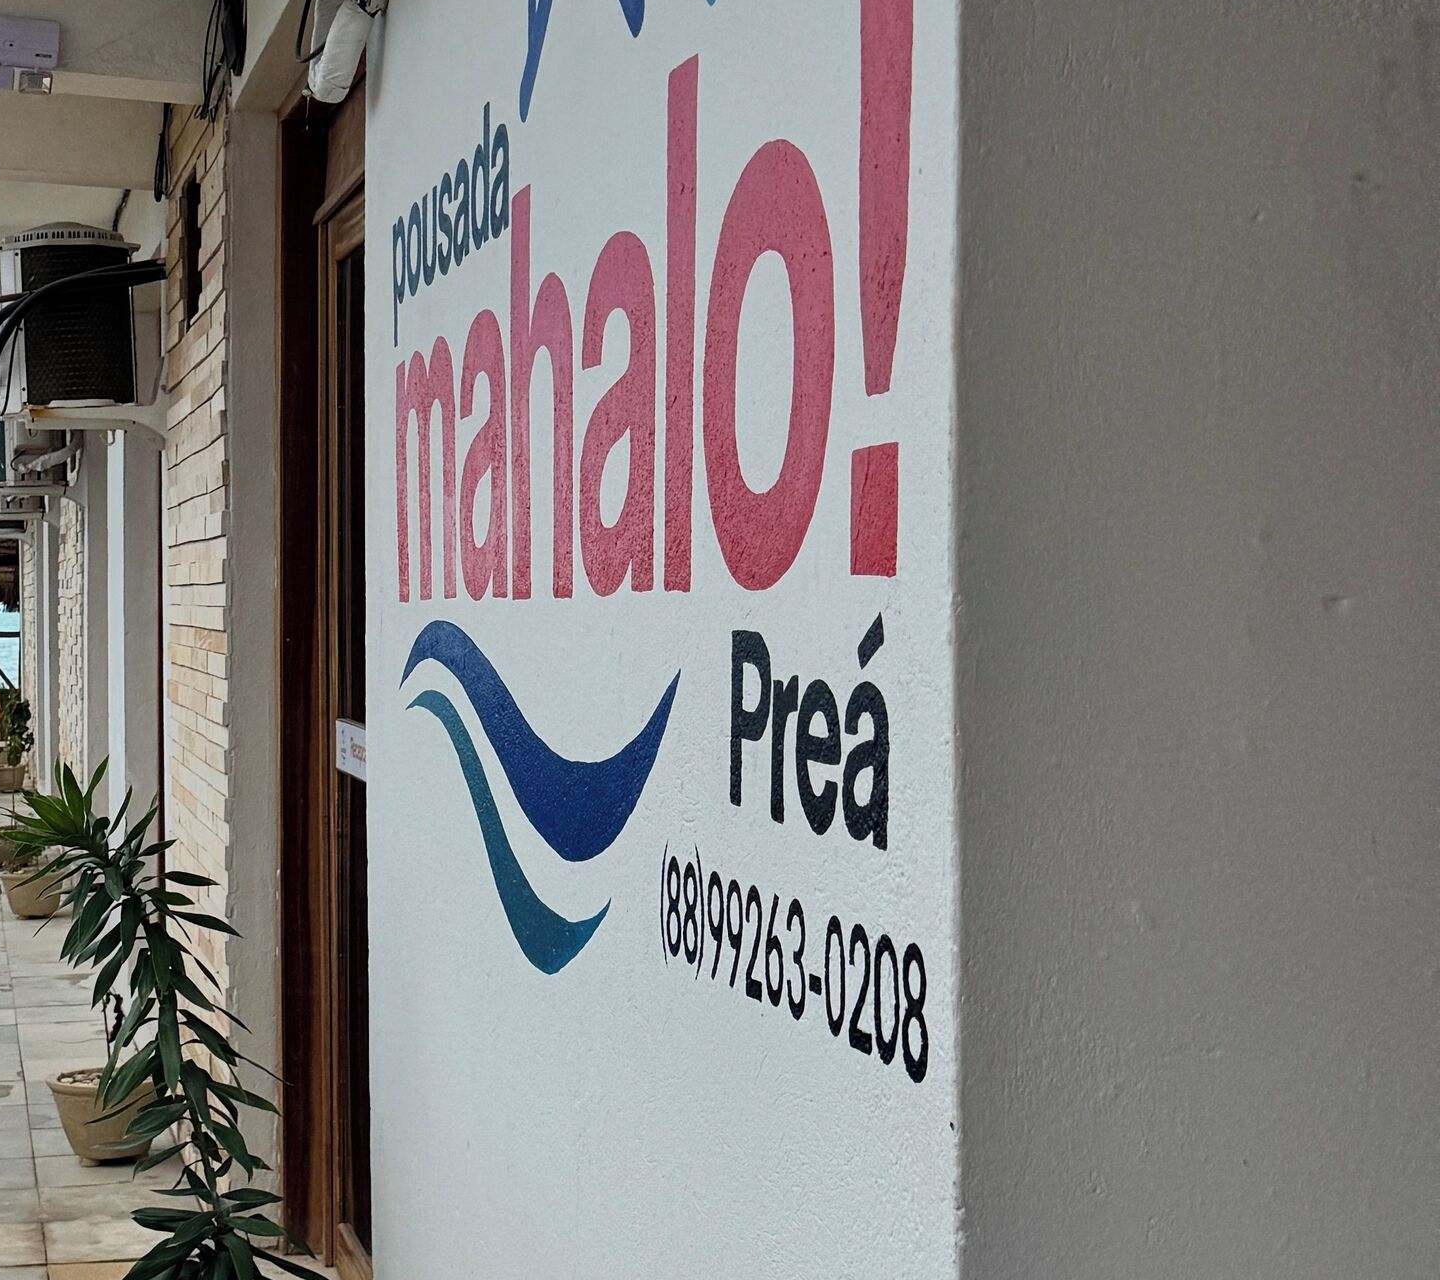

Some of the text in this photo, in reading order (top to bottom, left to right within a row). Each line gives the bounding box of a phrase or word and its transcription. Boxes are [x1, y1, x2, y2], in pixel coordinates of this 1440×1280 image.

[393, 101, 510, 348] pousada
[729, 611, 891, 852] Preá
[660, 839, 929, 1084] (88)99263-0208
